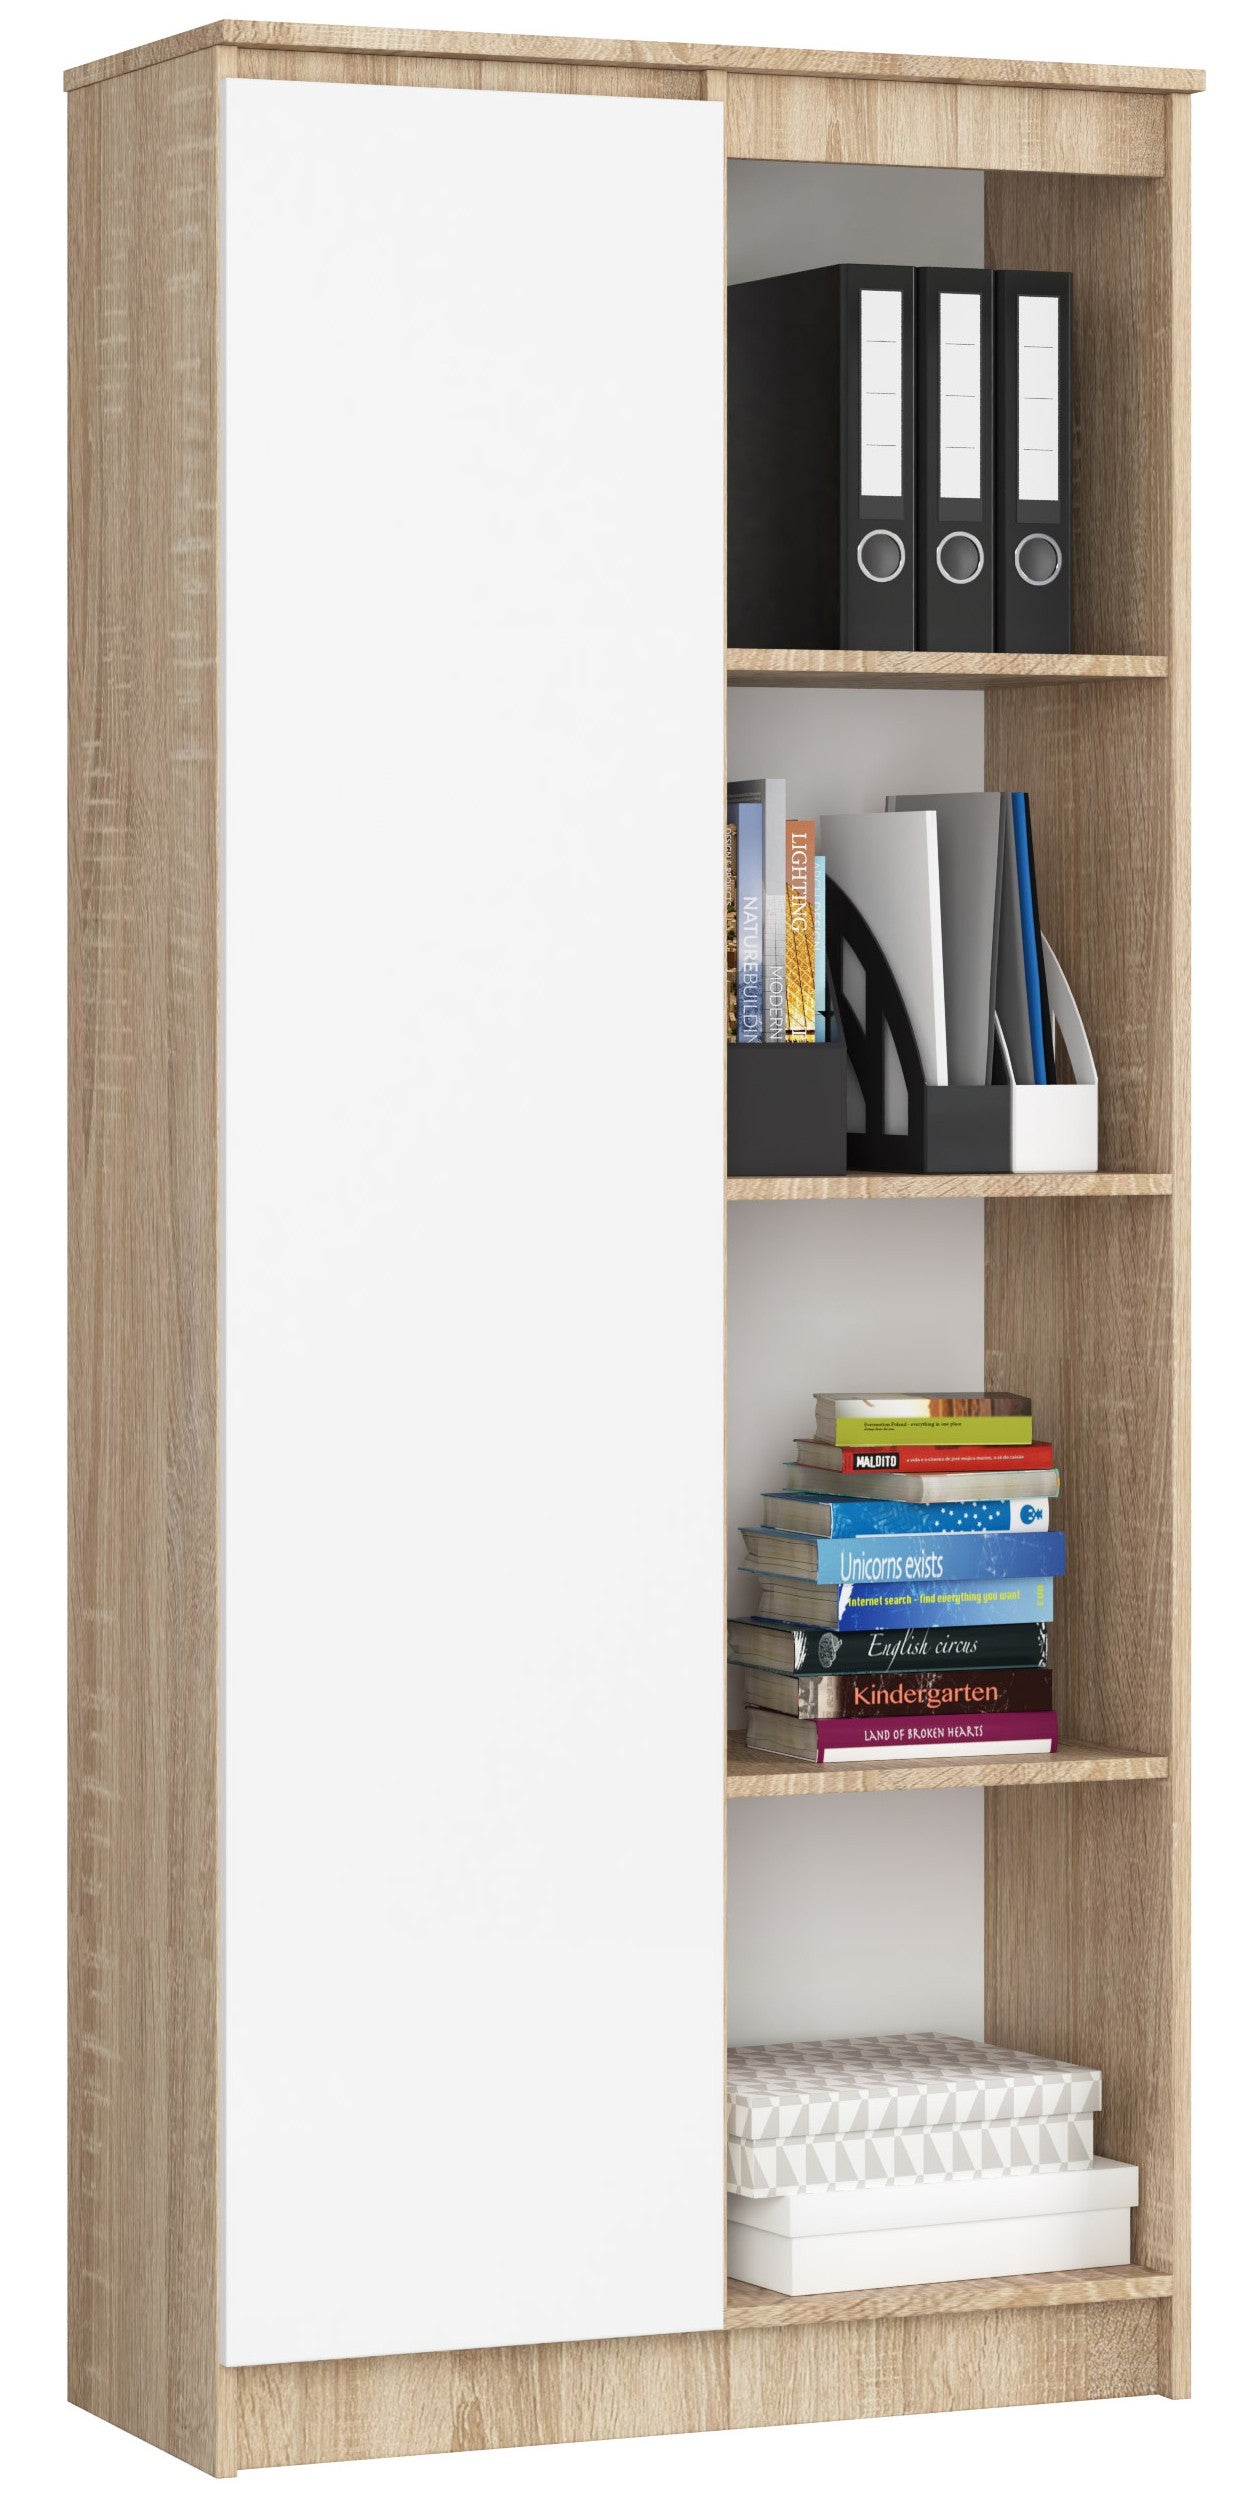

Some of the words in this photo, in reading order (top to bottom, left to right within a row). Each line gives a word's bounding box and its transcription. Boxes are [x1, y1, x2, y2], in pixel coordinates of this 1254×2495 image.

[791, 832, 807, 932] LIGHTING
[769, 966, 783, 1040] MODERN
[857, 1455, 897, 1469] MALDITO
[840, 1552, 902, 1581] Unicorns
[905, 1550, 943, 1579] exists
[884, 1594, 912, 1605] search
[919, 1592, 936, 1604] find
[937, 1591, 981, 1606] everything
[983, 1592, 997, 1604] you
[998, 1590, 1021, 1602] want
[867, 1629, 931, 1672] English
[934, 1634, 978, 1654] circus
[854, 1684, 998, 1708] Kindergarten
[864, 1729, 891, 1742] LAND
[893, 1729, 904, 1741] OF
[907, 1727, 945, 1740] BROKEN
[947, 1725, 983, 1738] HEARTS
